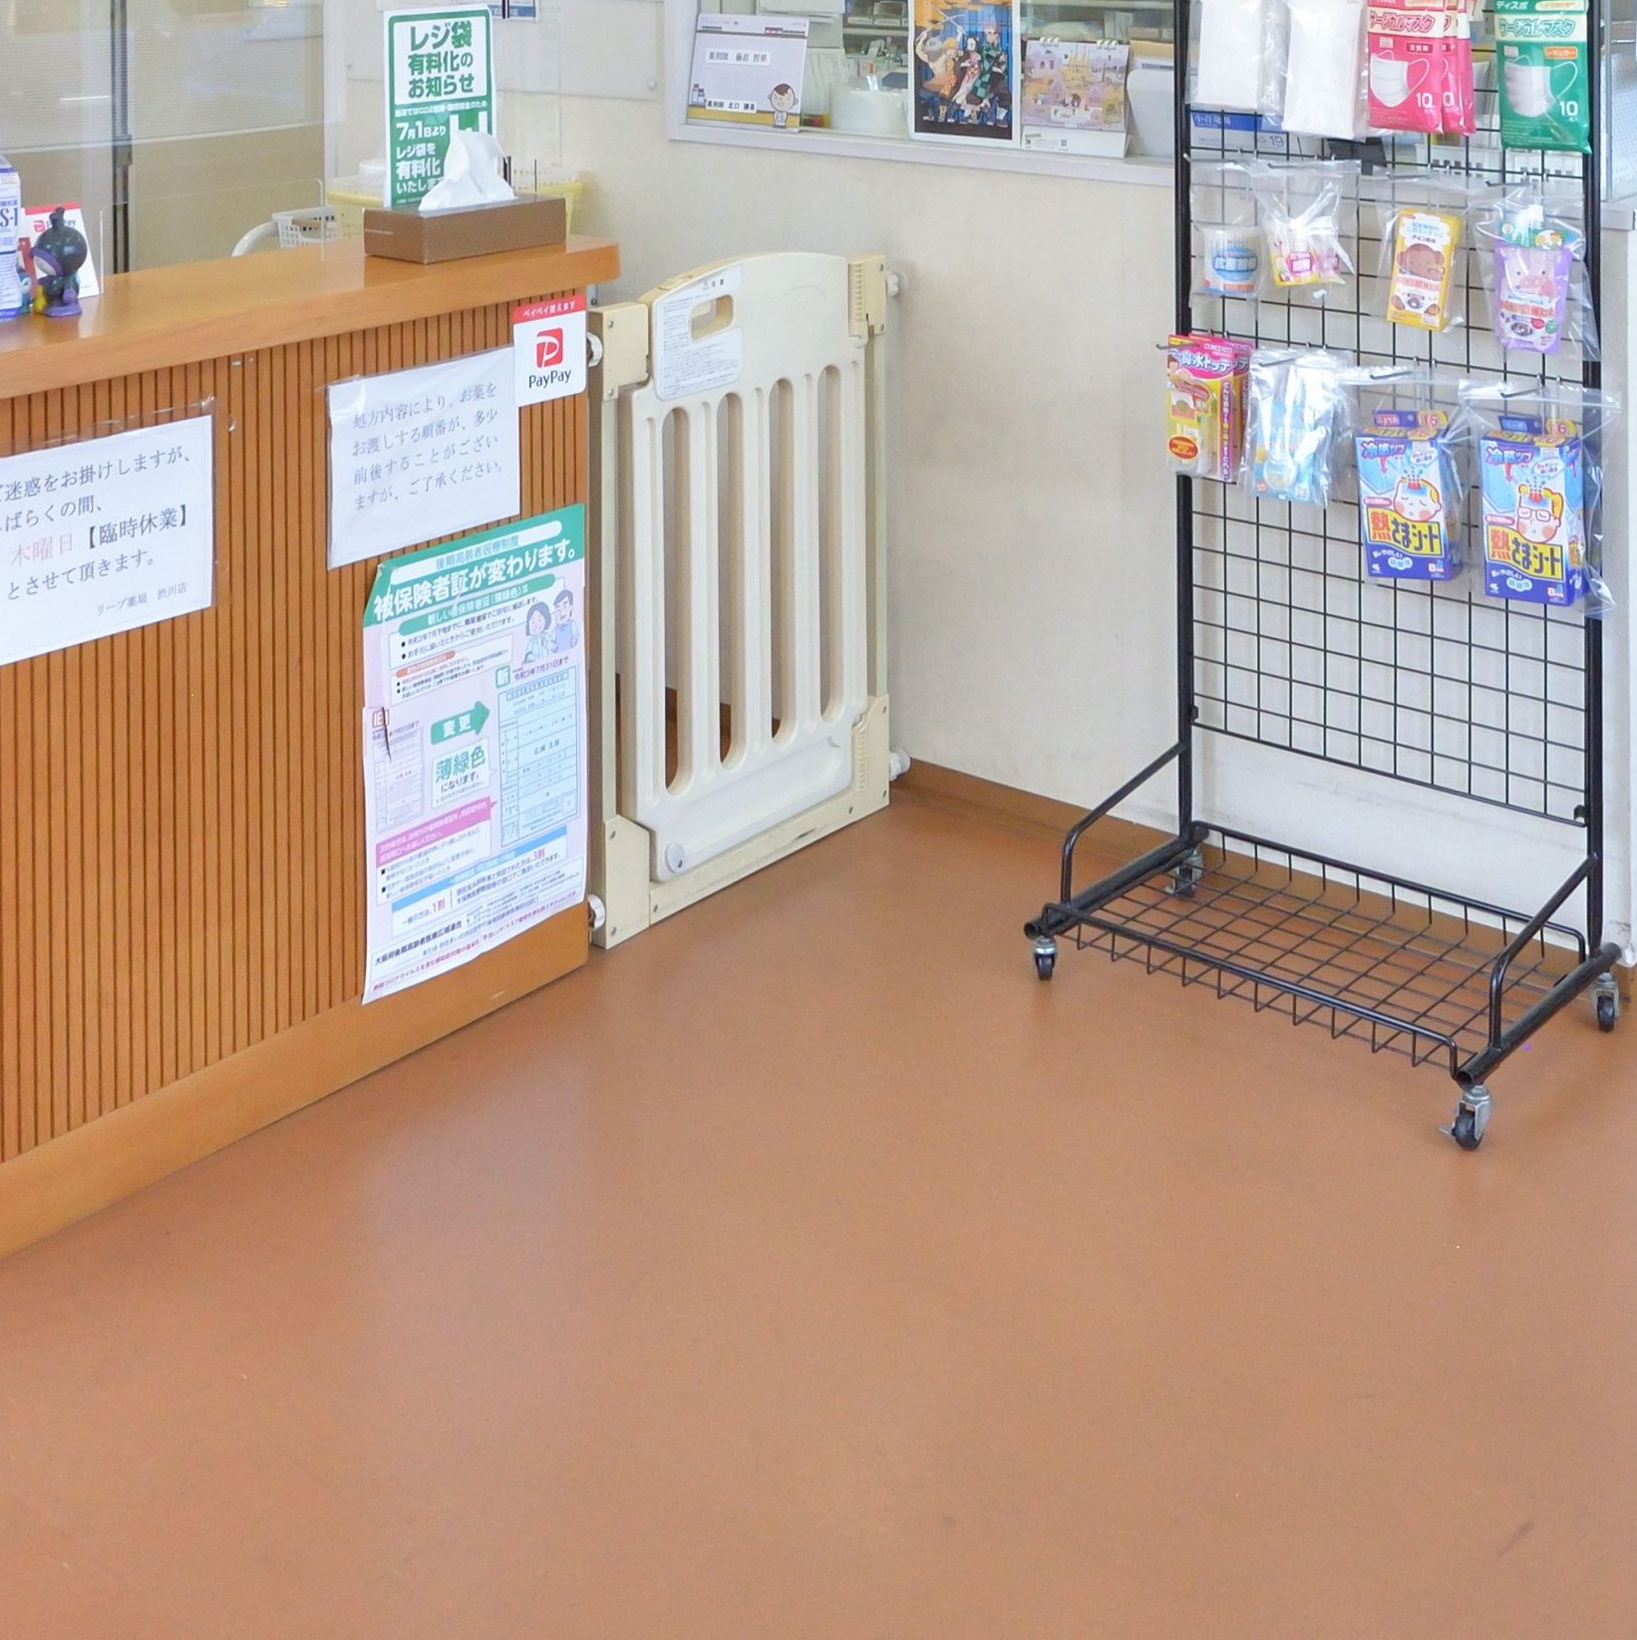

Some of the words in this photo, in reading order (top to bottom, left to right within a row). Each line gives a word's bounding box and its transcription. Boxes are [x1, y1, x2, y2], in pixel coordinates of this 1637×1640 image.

[1496, 1, 1529, 10] ディスポ
[410, 20, 472, 51] レジ袋
[408, 50, 473, 76] 有料化の
[408, 73, 474, 99] お知らせ
[1416, 93, 1434, 108] 10
[1559, 101, 1578, 117] 10
[396, 120, 447, 141] 7月1日より
[1269, 136, 1284, 147] 19
[396, 143, 436, 159] レジ袋を
[396, 158, 441, 180] 有料化
[396, 176, 444, 195] いたしま
[523, 301, 576, 317] ペイペイ使えます
[528, 369, 572, 389] PayPay
[353, 382, 497, 430] 処方内容により、お薬を
[352, 408, 498, 458] お渡しする順番が、多少
[353, 434, 498, 486] 前後することがござい
[354, 461, 503, 511] ますが、ご了承ください。
[10, 532, 74, 568] 木曜日
[89, 504, 187, 550] 【臨時休業】
[1371, 510, 1439, 552] 熱さまシート
[1490, 528, 1562, 577] 熱さまシート
[7, 548, 154, 601] とさせて頂きます。
[373, 538, 576, 621] 被保険者証が変わります。
[97, 591, 147, 617] リープ薬局
[157, 582, 188, 601] 渋川店
[497, 668, 510, 686] 新
[443, 714, 472, 738] 変更
[436, 745, 486, 783] 薄緑色
[441, 771, 480, 793] になります。
